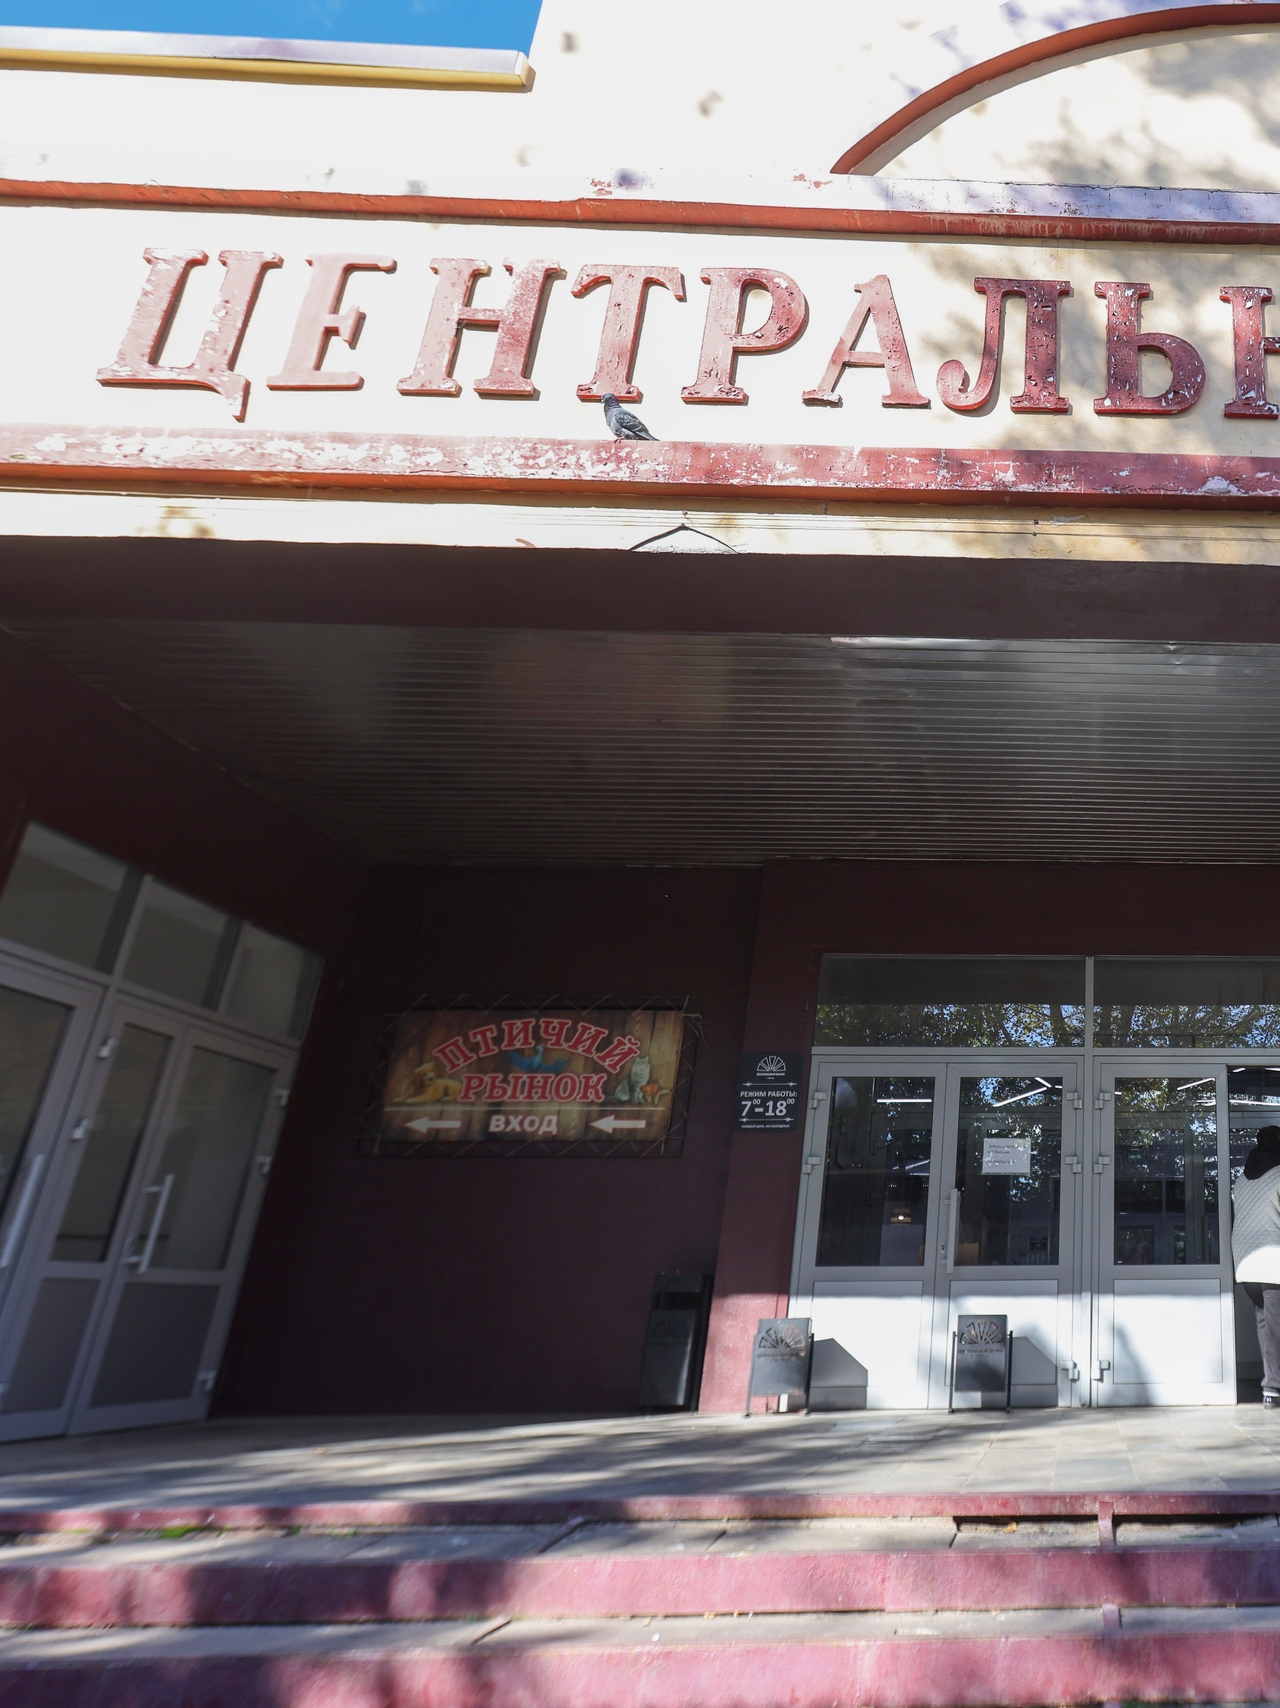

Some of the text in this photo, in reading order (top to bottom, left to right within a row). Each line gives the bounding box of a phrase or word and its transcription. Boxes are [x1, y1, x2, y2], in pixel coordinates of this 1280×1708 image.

[432, 1018, 641, 1074] ПТИЧИЙ
[457, 1073, 607, 1103] РЫНОК
[767, 1090, 798, 1098] РАБОТЫ:
[488, 1115, 559, 1136] ВХОД
